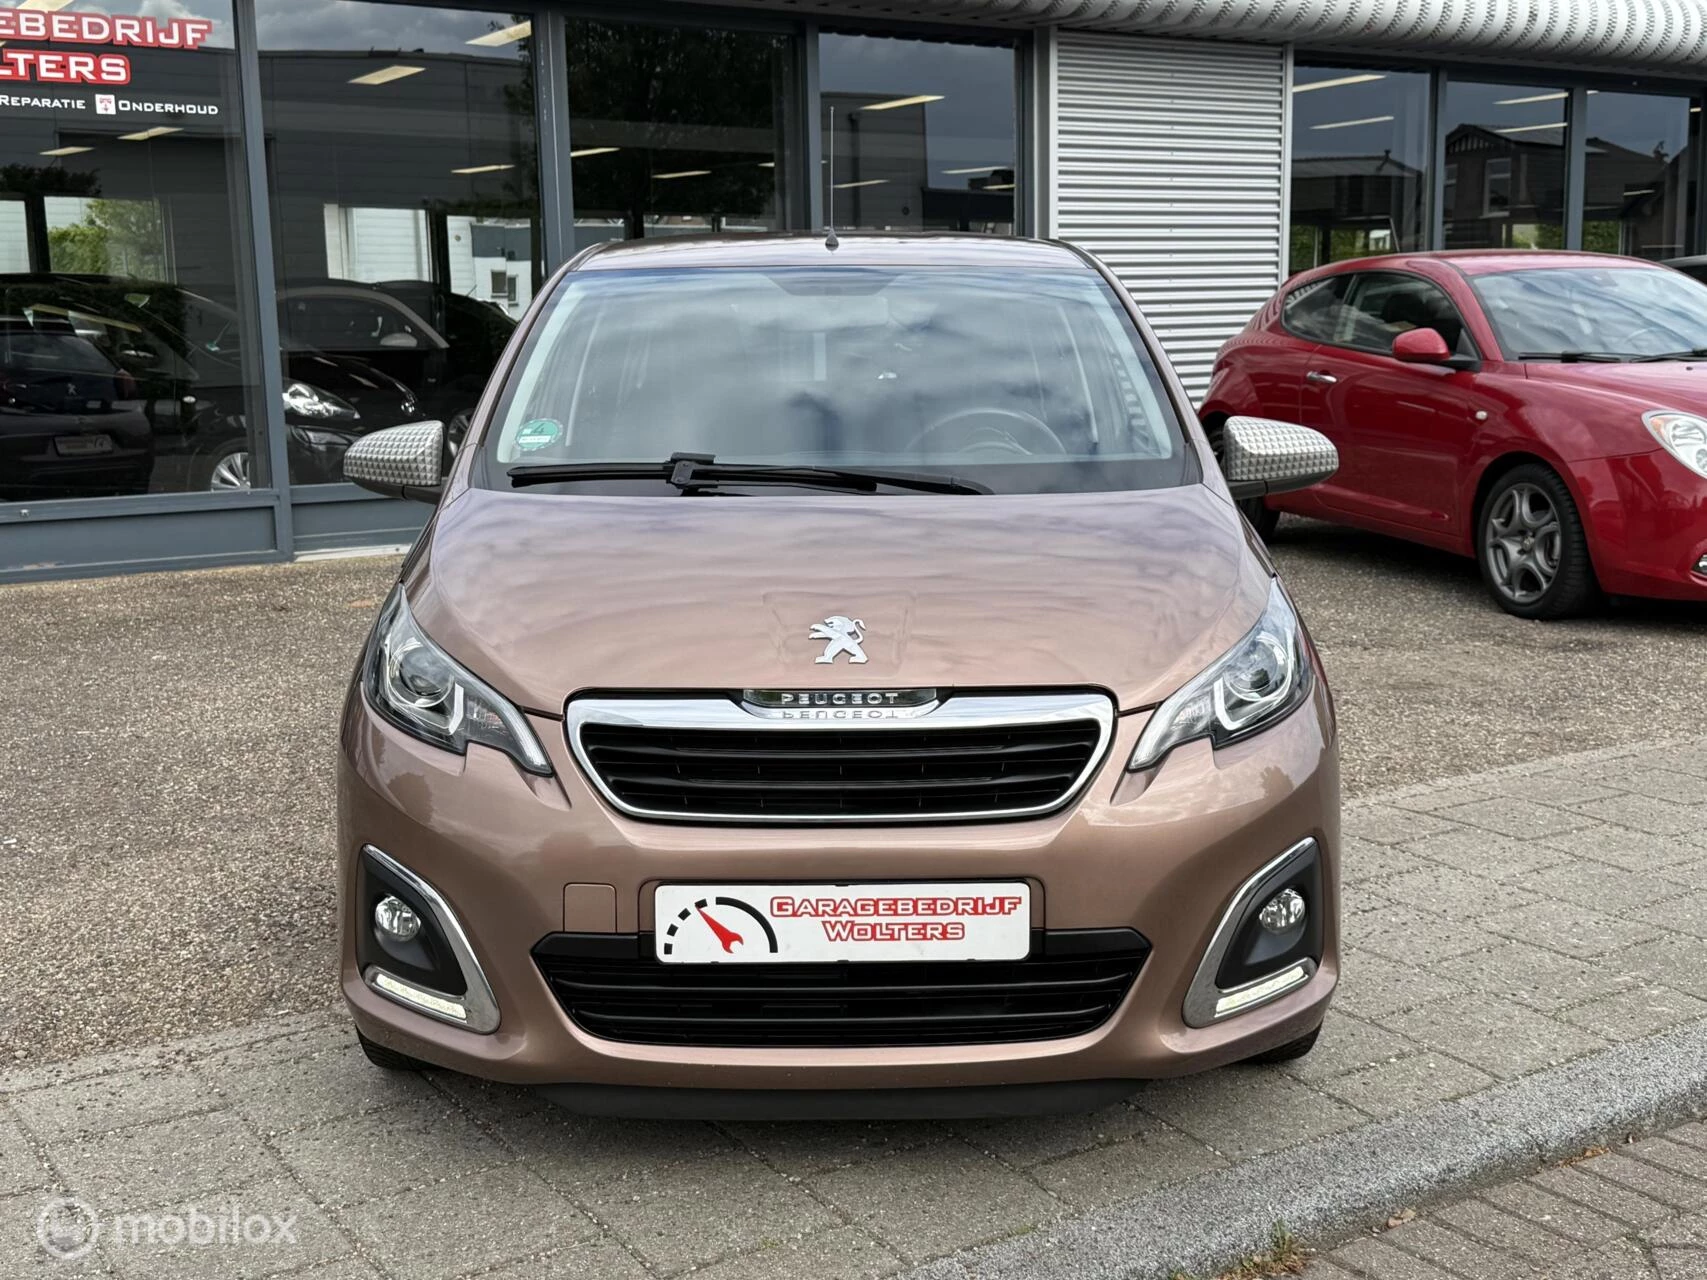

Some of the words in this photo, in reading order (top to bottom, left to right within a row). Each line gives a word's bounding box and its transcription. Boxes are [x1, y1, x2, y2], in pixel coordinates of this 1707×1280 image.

[0, 10, 210, 47] EBEDRIJF
[0, 94, 86, 110] REPARATIE
[118, 100, 219, 115] ONDERHOUD
[781, 692, 899, 705] PEUGEOT
[770, 896, 1022, 917] GARAGEBEDRIJF
[821, 920, 965, 942] WOLTERS
